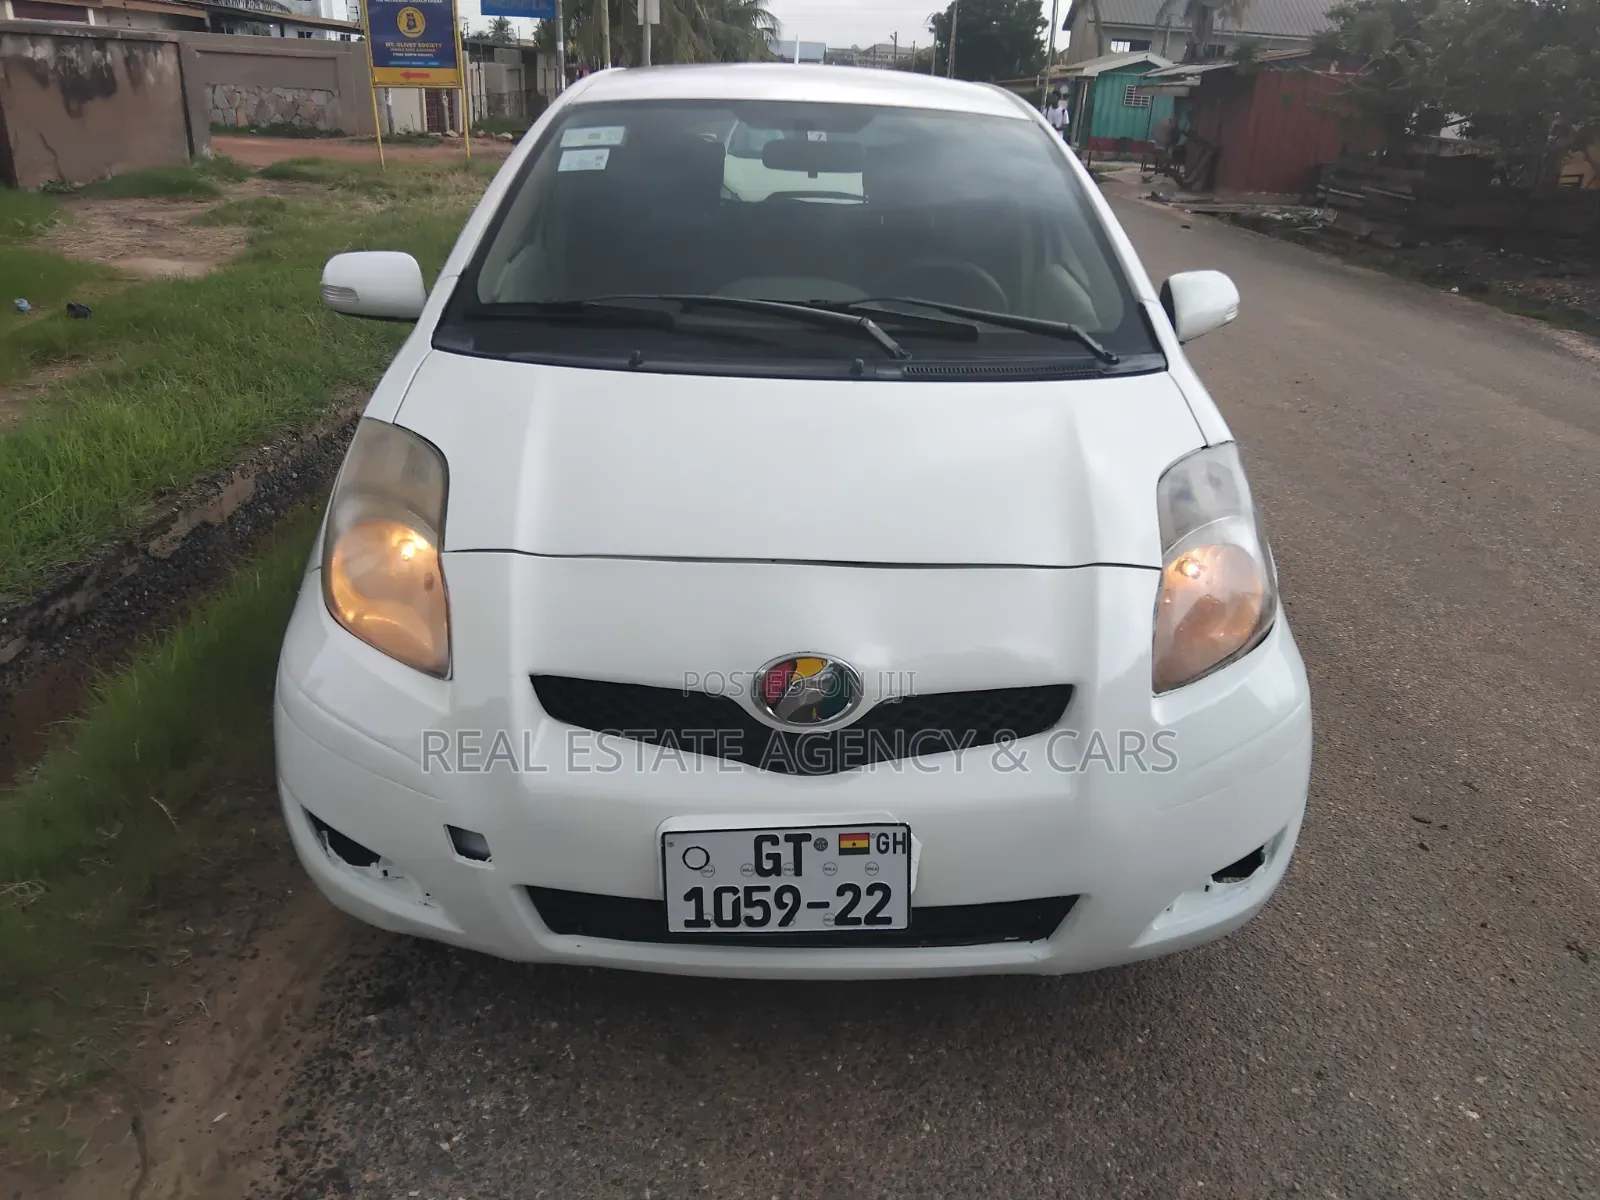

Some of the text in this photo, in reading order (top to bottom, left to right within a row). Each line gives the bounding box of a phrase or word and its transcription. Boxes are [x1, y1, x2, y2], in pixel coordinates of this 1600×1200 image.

[754, 832, 907, 878] GT GH
[683, 882, 893, 928] 1059-22
